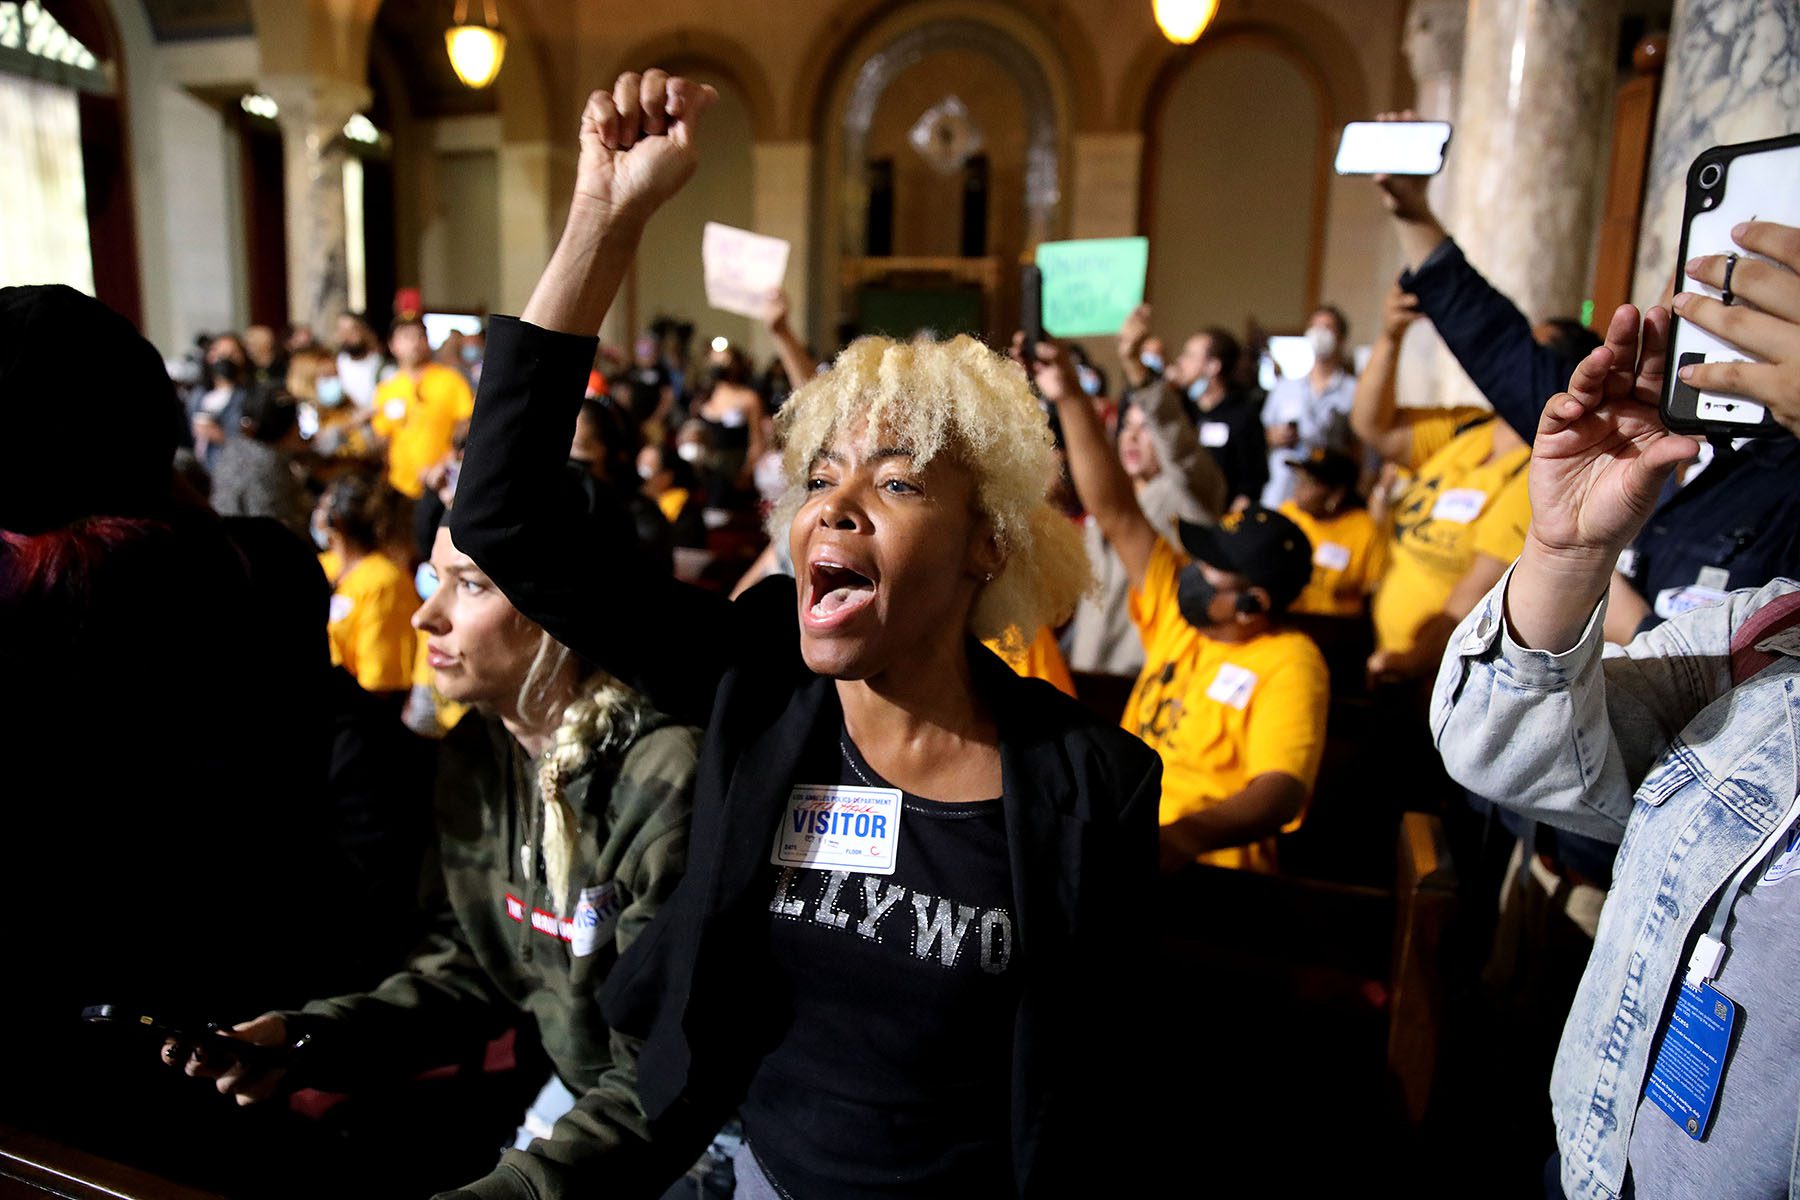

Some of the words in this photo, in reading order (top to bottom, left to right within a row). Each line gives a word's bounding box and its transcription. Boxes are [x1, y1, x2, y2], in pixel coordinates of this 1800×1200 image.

[805, 794, 829, 802] ANGELES
[831, 795, 851, 803] POLICE
[853, 797, 892, 805] DEPARTMENT
[793, 809, 887, 838] VISITOR
[1673, 1011, 1689, 1028] Access
